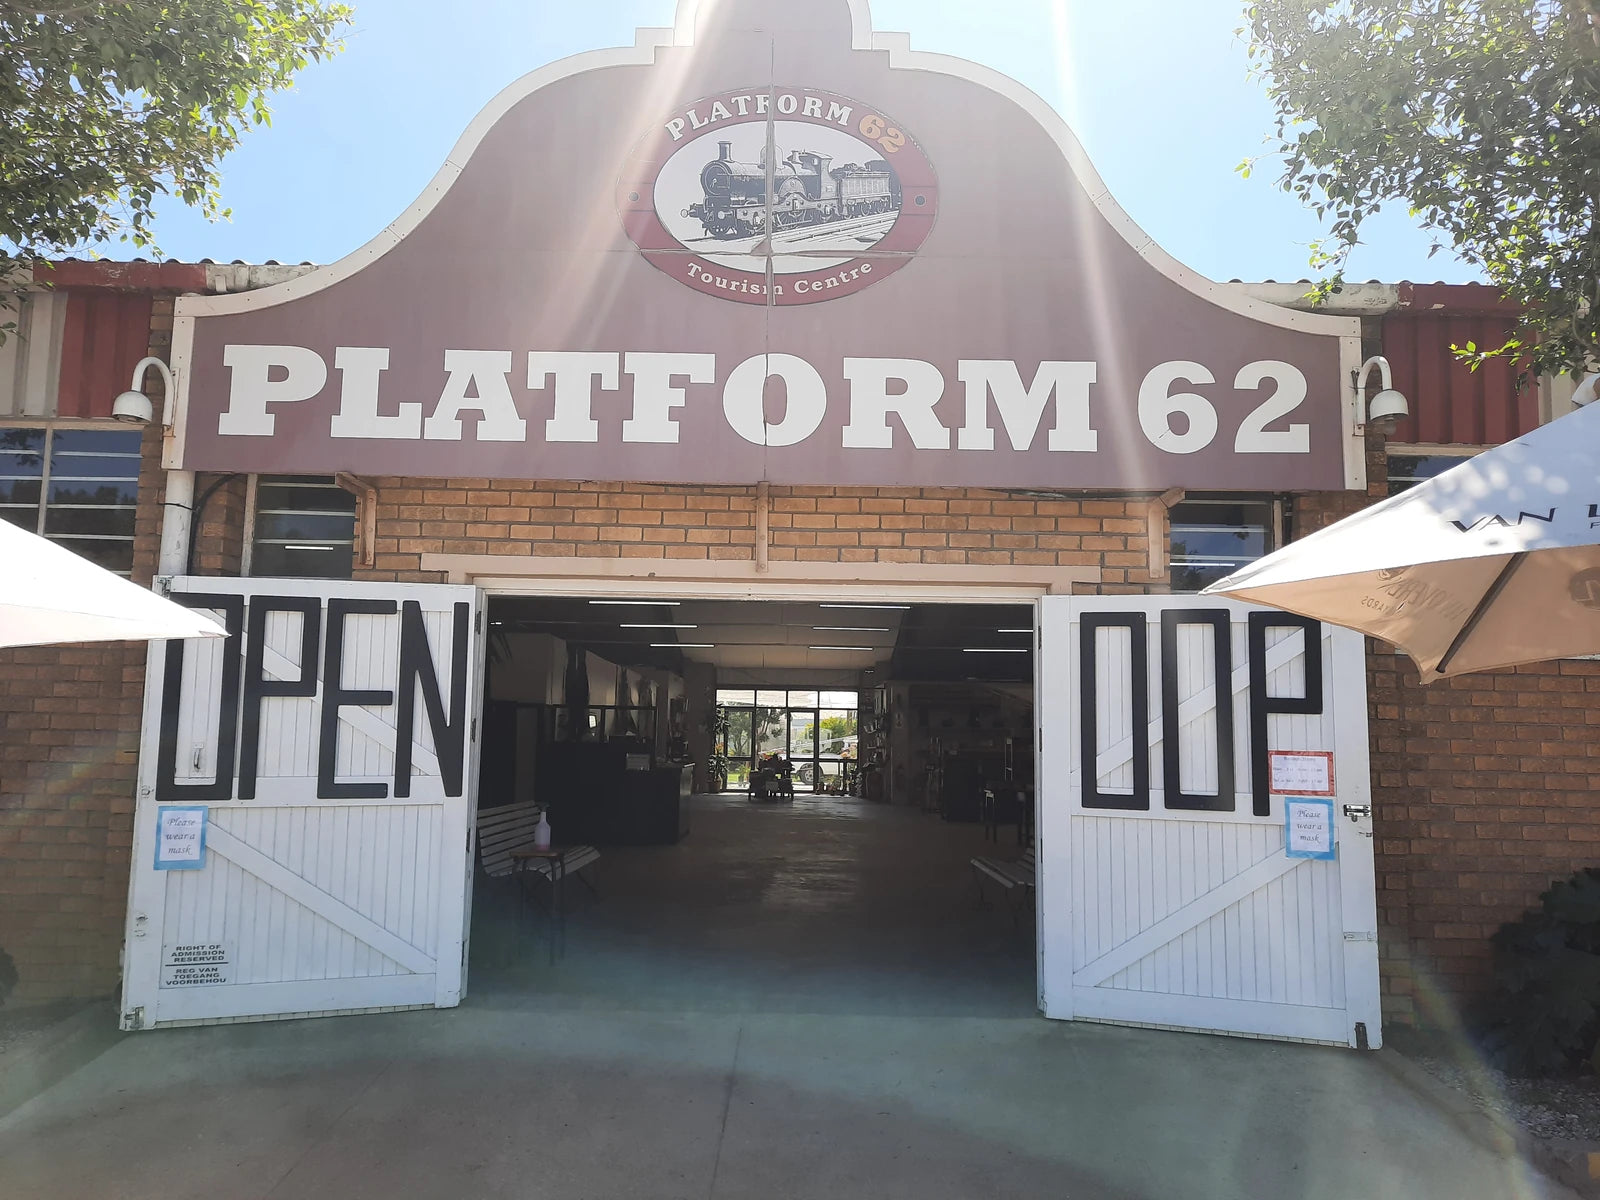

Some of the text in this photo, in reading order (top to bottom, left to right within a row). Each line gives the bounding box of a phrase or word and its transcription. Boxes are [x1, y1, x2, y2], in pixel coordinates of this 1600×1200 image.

[664, 94, 906, 153] PLATFORM 62
[687, 262, 873, 295] Tourism Centre
[217, 344, 1311, 454] PLATFORM 62
[1446, 506, 1559, 533] VAN
[155, 592, 469, 801] OPEN
[1080, 609, 1323, 816] OOP
[1297, 809, 1321, 818] Please
[167, 817, 196, 827] Please
[1300, 834, 1321, 844] mask
[168, 844, 193, 856] mask
[173, 955, 225, 963] RESERVED
[165, 978, 227, 986] VOORBEHOU
[173, 972, 220, 980] TOEGANG
